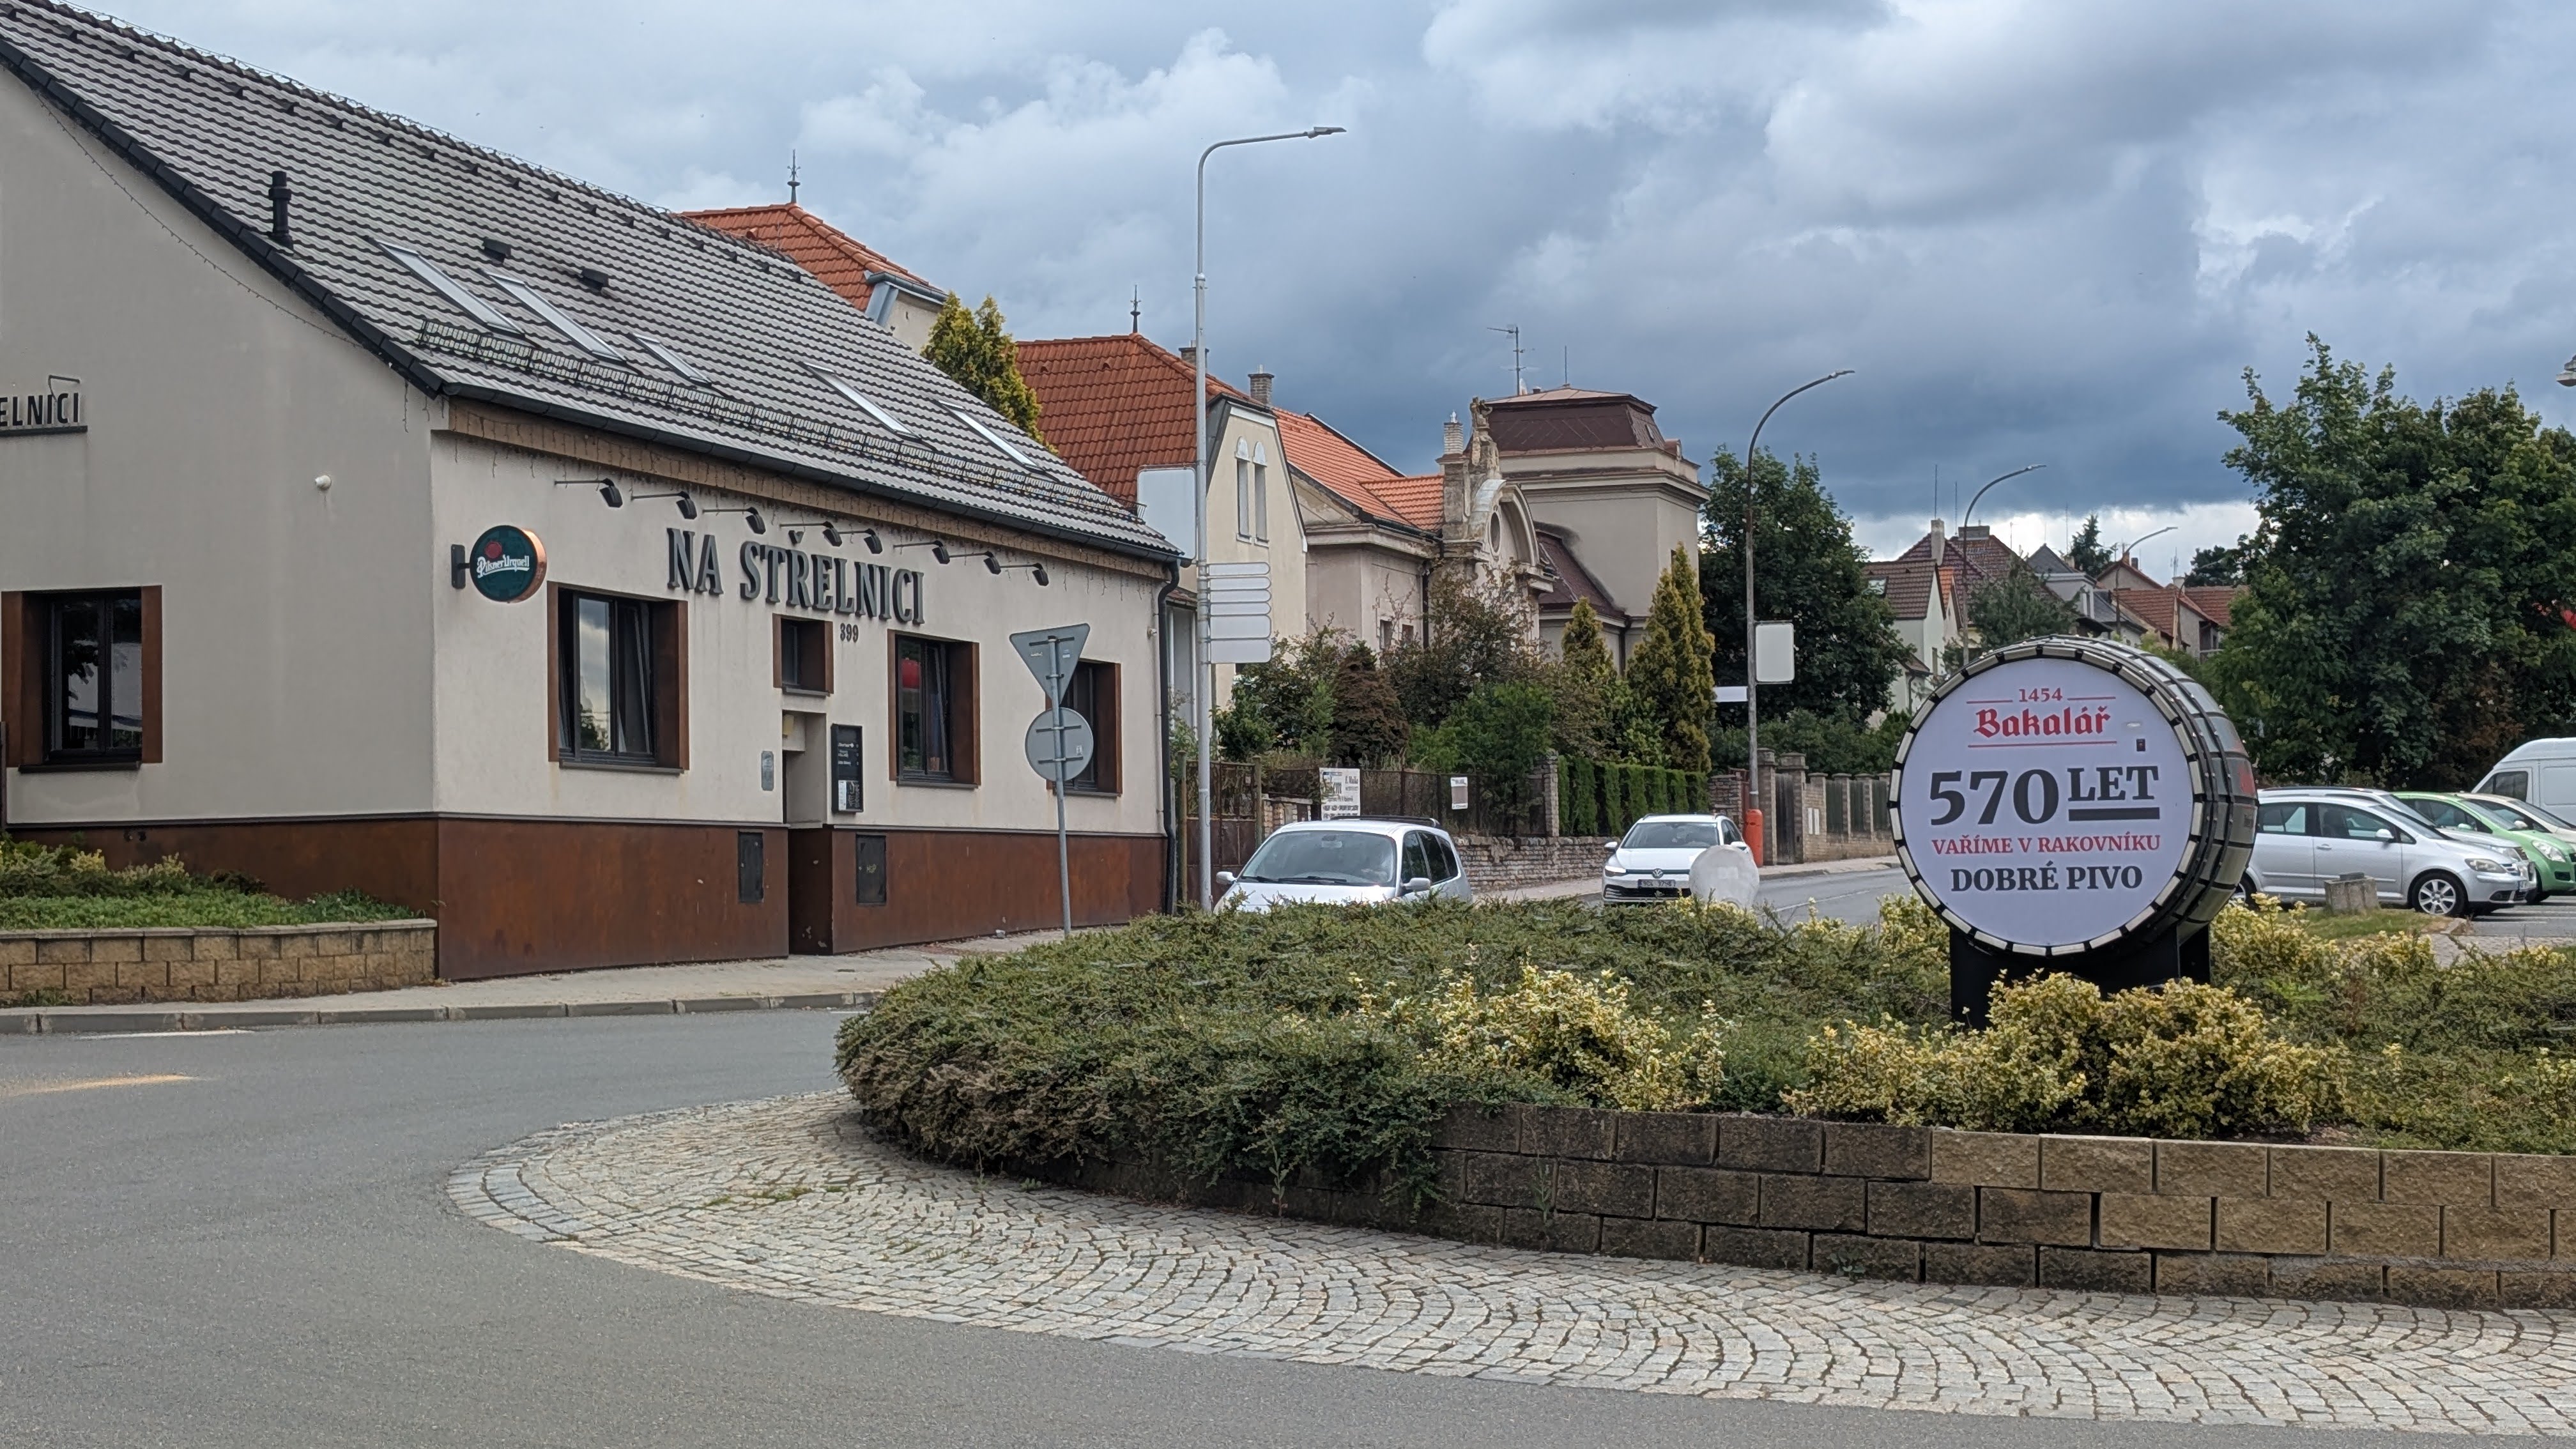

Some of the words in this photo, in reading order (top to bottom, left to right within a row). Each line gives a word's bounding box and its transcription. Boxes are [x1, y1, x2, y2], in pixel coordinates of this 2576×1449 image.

[0, 392, 79, 427] ELNICI
[477, 556, 503, 578] Pilsner
[503, 554, 530, 572] Urquell
[666, 528, 724, 595] NA
[740, 530, 924, 625] STŘELNICI
[840, 623, 859, 643] 399
[2019, 687, 2063, 703] 1454
[1974, 705, 2111, 739] Bakalář
[1929, 769, 2059, 825] 570
[2067, 765, 2159, 802] LET
[1931, 835, 2013, 855] VAŘÍME
[2018, 838, 2032, 853] V
[2037, 832, 2161, 852] RAKOVNÍKU
[1951, 861, 2059, 892] DOBRÉ
[2066, 865, 2143, 890] PIVO
